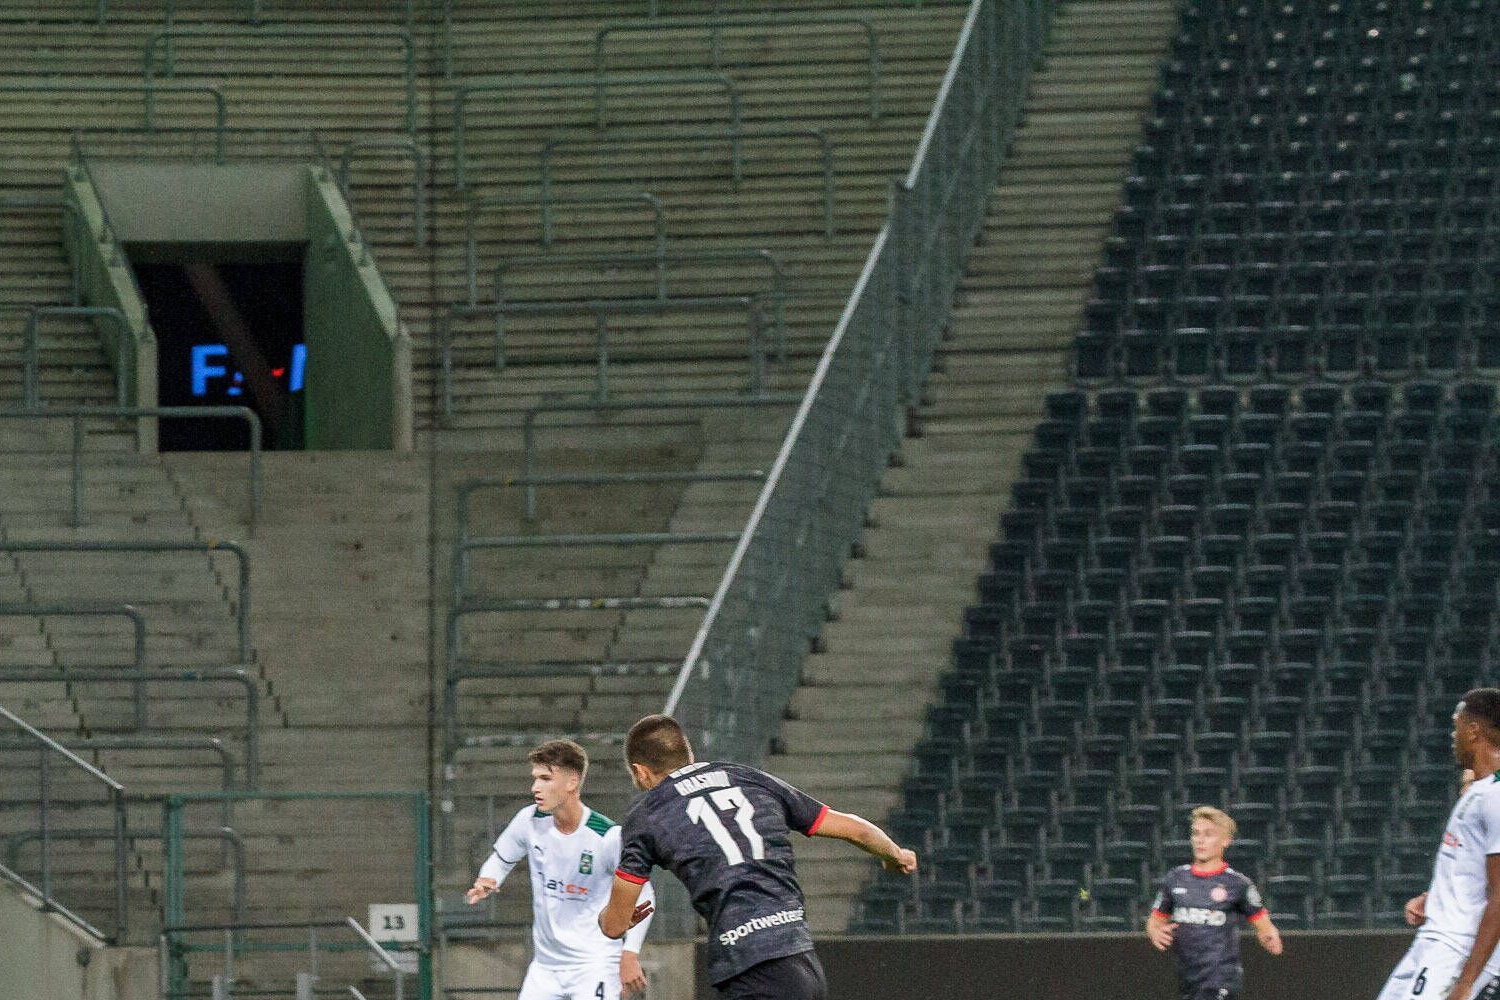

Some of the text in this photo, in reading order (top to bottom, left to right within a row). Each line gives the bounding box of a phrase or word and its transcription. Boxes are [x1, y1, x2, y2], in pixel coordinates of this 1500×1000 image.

[686, 786, 766, 866] 17
[383, 915, 406, 930] 13
[1412, 966, 1428, 996] 6
